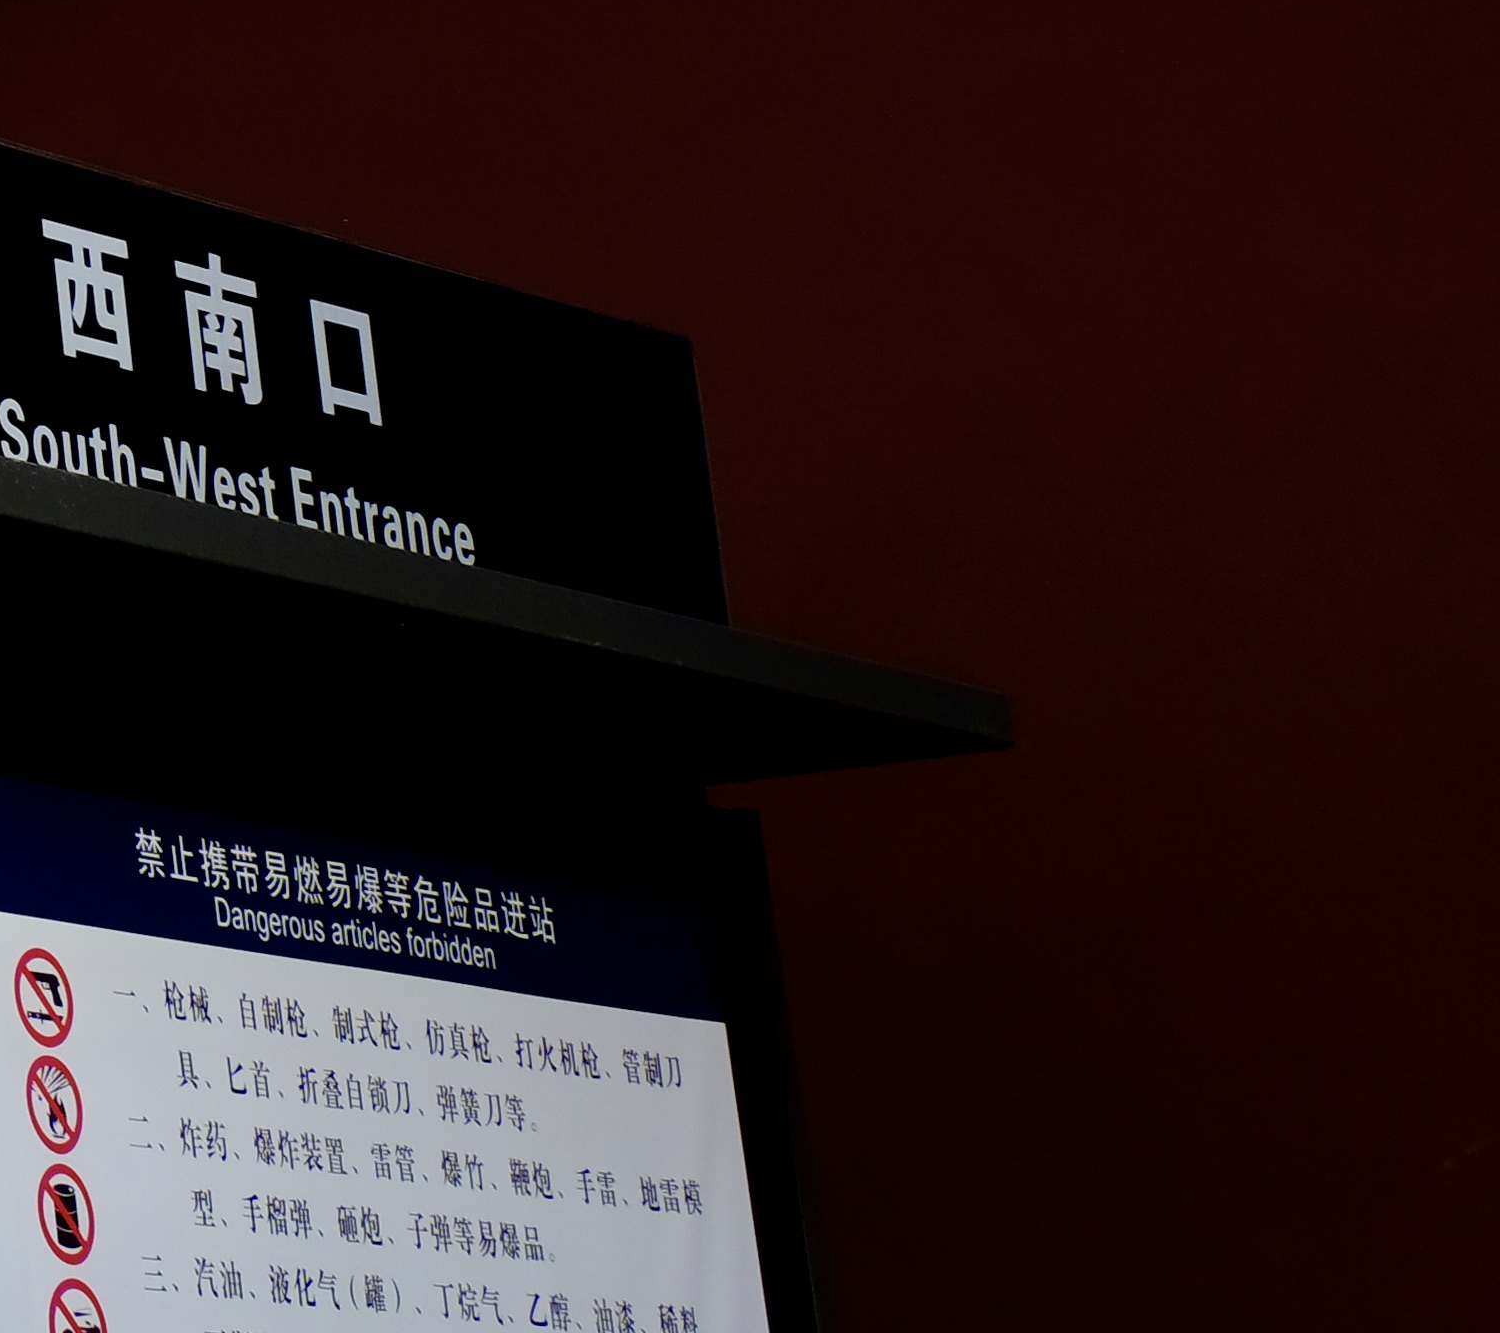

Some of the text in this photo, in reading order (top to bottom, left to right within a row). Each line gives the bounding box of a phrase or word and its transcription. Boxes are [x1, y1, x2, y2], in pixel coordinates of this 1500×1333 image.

[41, 217, 385, 427] 西南口
[289, 465, 477, 568] Entrance
[134, 826, 557, 945] 禁止携带易燃易爆等危险品进站
[214, 895, 497, 970] Dangerous articles forbidden
